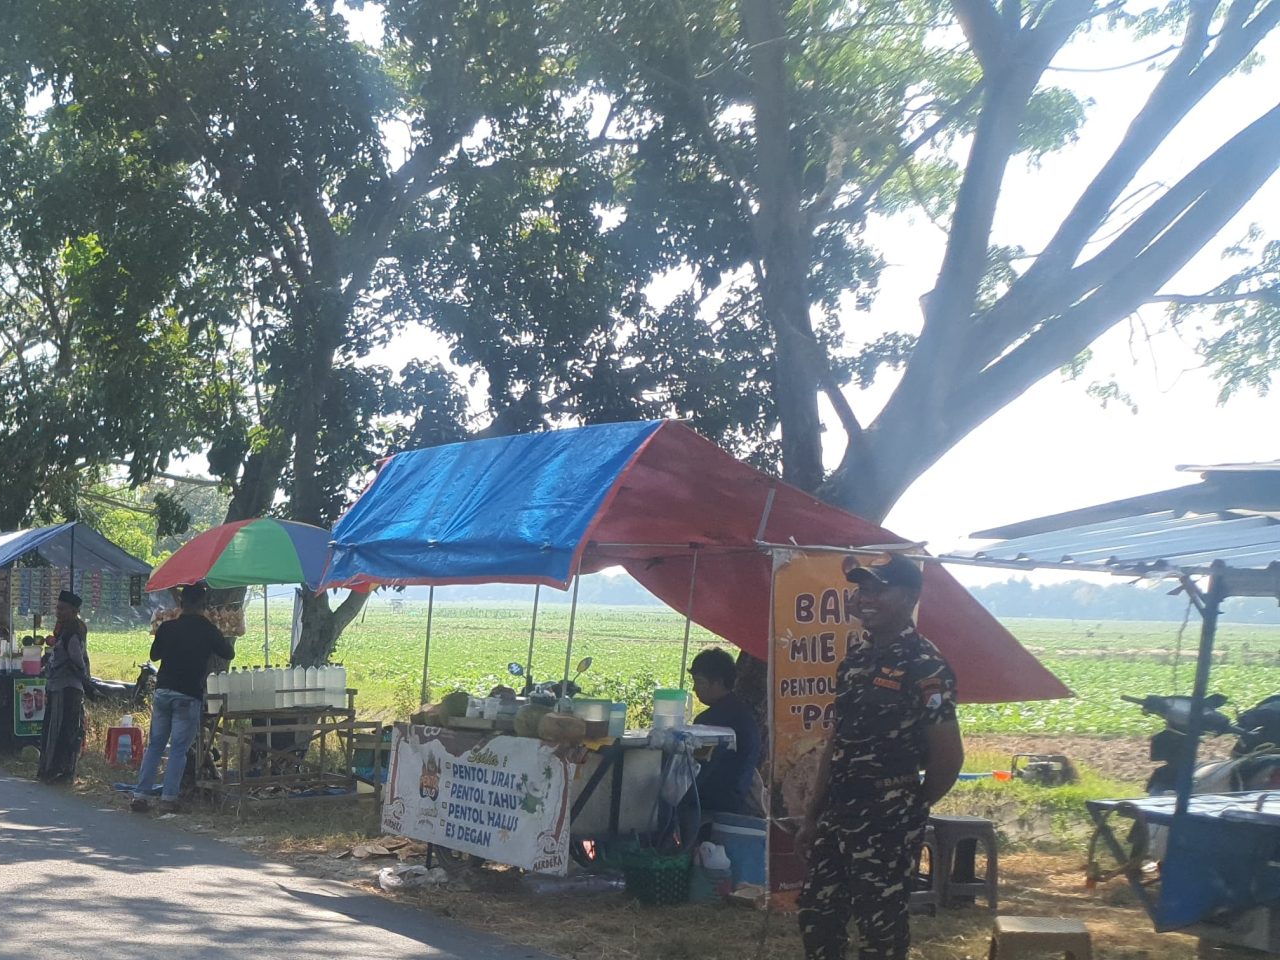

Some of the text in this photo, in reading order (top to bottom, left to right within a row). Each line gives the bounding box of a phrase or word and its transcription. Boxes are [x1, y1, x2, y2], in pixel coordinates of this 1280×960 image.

[789, 631, 837, 663] MIE
[452, 762, 516, 789] PENTOL URAT
[450, 782, 486, 804] PENTOL
[488, 790, 517, 810] TAHU
[448, 802, 484, 825] PENTOL
[487, 811, 519, 832] HALUS
[445, 821, 456, 838] ES
[457, 825, 491, 847] DEGAN
